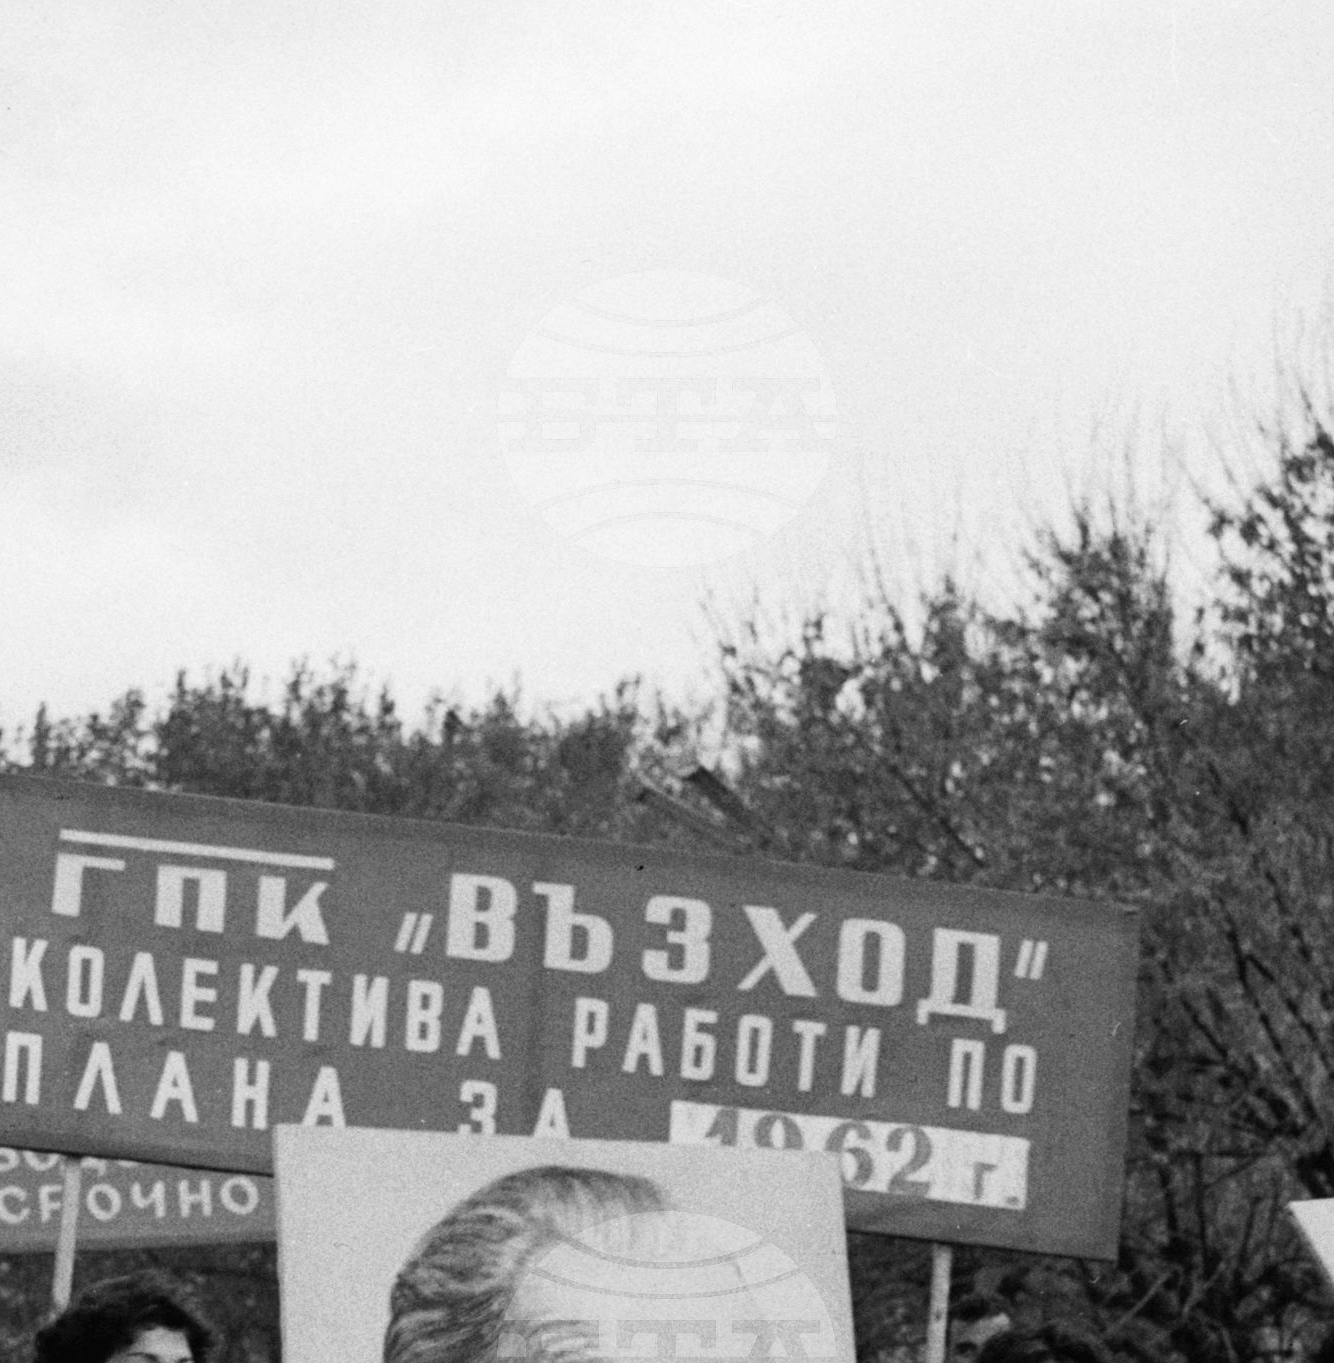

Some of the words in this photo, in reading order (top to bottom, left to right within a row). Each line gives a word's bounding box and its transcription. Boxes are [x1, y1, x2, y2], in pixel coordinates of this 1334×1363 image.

[51, 852, 331, 945] ГПК
[8, 936, 501, 1060] КОЛЕКТИВА
[571, 997, 881, 1098] РАБОТИ
[946, 1038, 1037, 1113] ПО
[2, 1030, 347, 1129] ПЛАНА
[458, 1079, 571, 1138] ЗА
